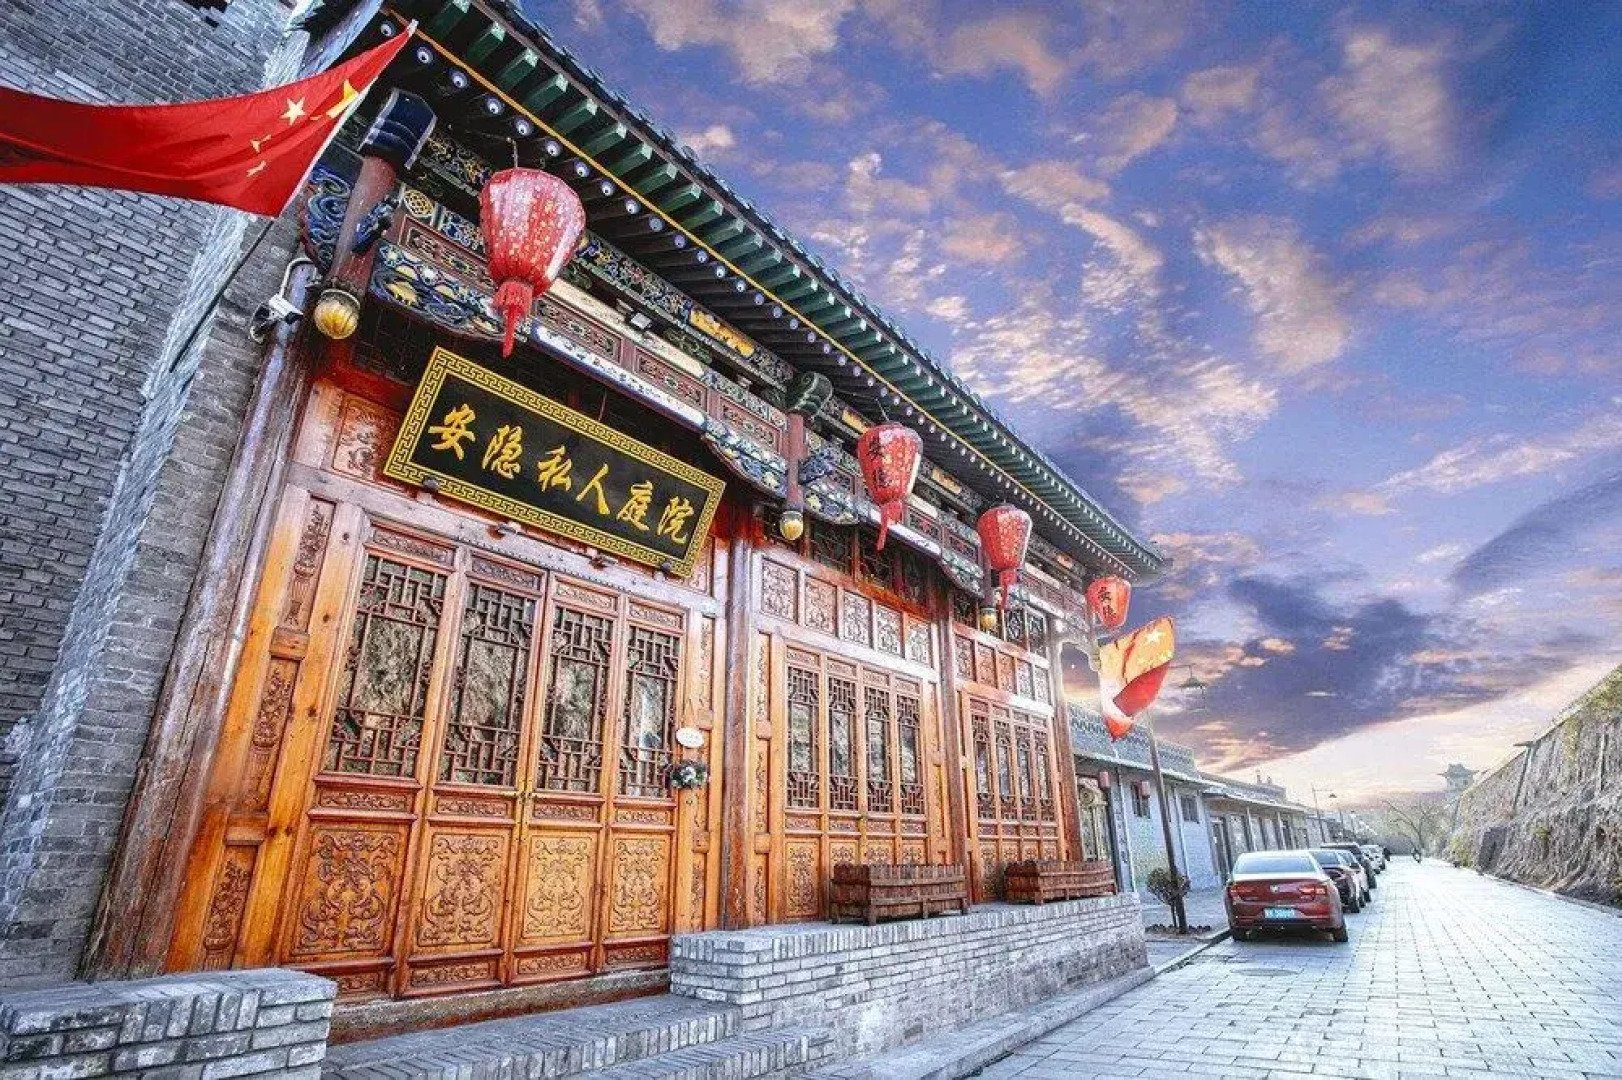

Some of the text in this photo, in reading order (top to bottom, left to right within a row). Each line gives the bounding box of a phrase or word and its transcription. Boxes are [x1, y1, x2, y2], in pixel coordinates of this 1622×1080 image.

[428, 403, 694, 544] 安隐私人庭院
